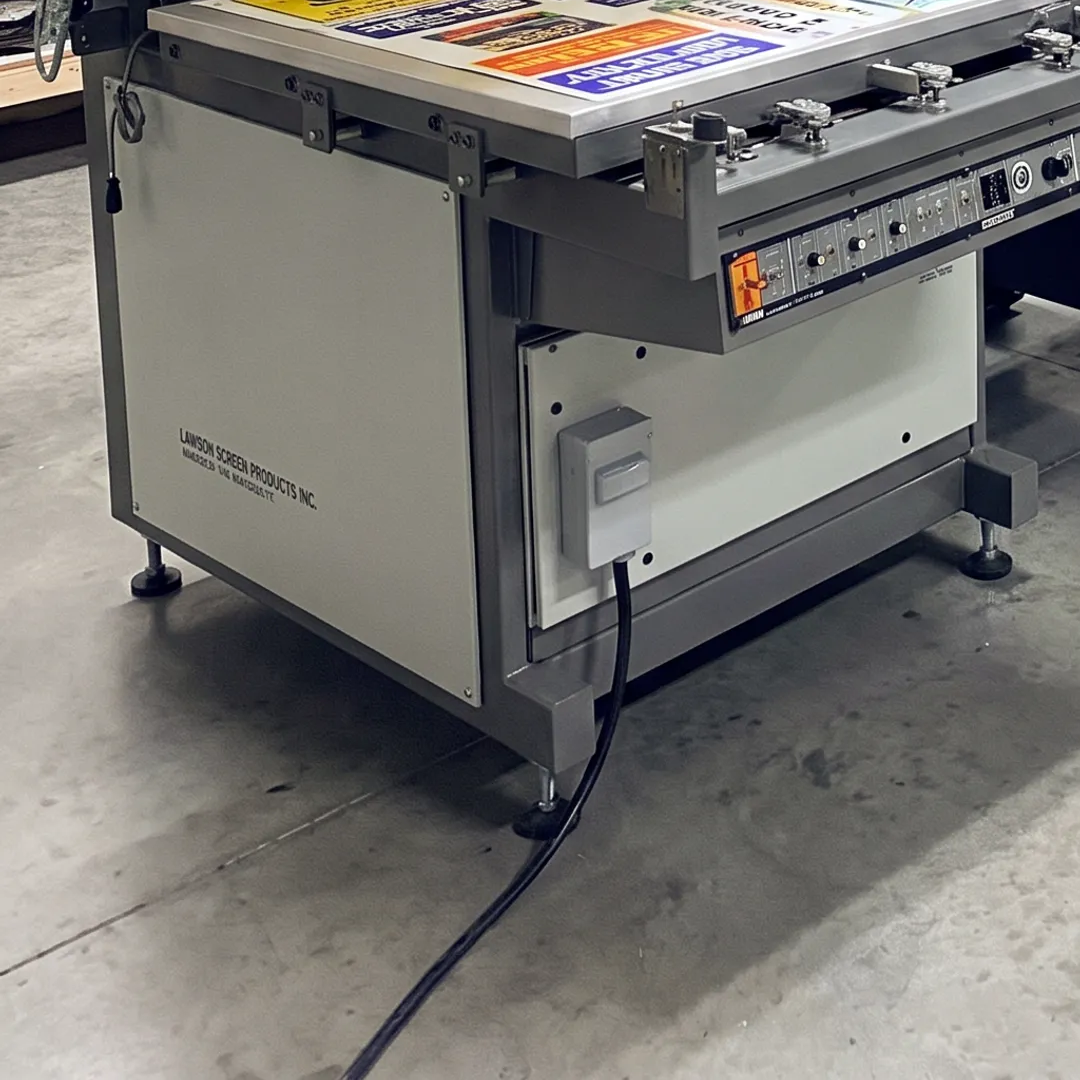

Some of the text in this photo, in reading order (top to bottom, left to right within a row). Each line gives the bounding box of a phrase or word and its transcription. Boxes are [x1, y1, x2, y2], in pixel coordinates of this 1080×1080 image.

[180, 428, 214, 457] LAWSON
[216, 445, 248, 475] SCREEN
[250, 461, 297, 500] PRODUCTS
